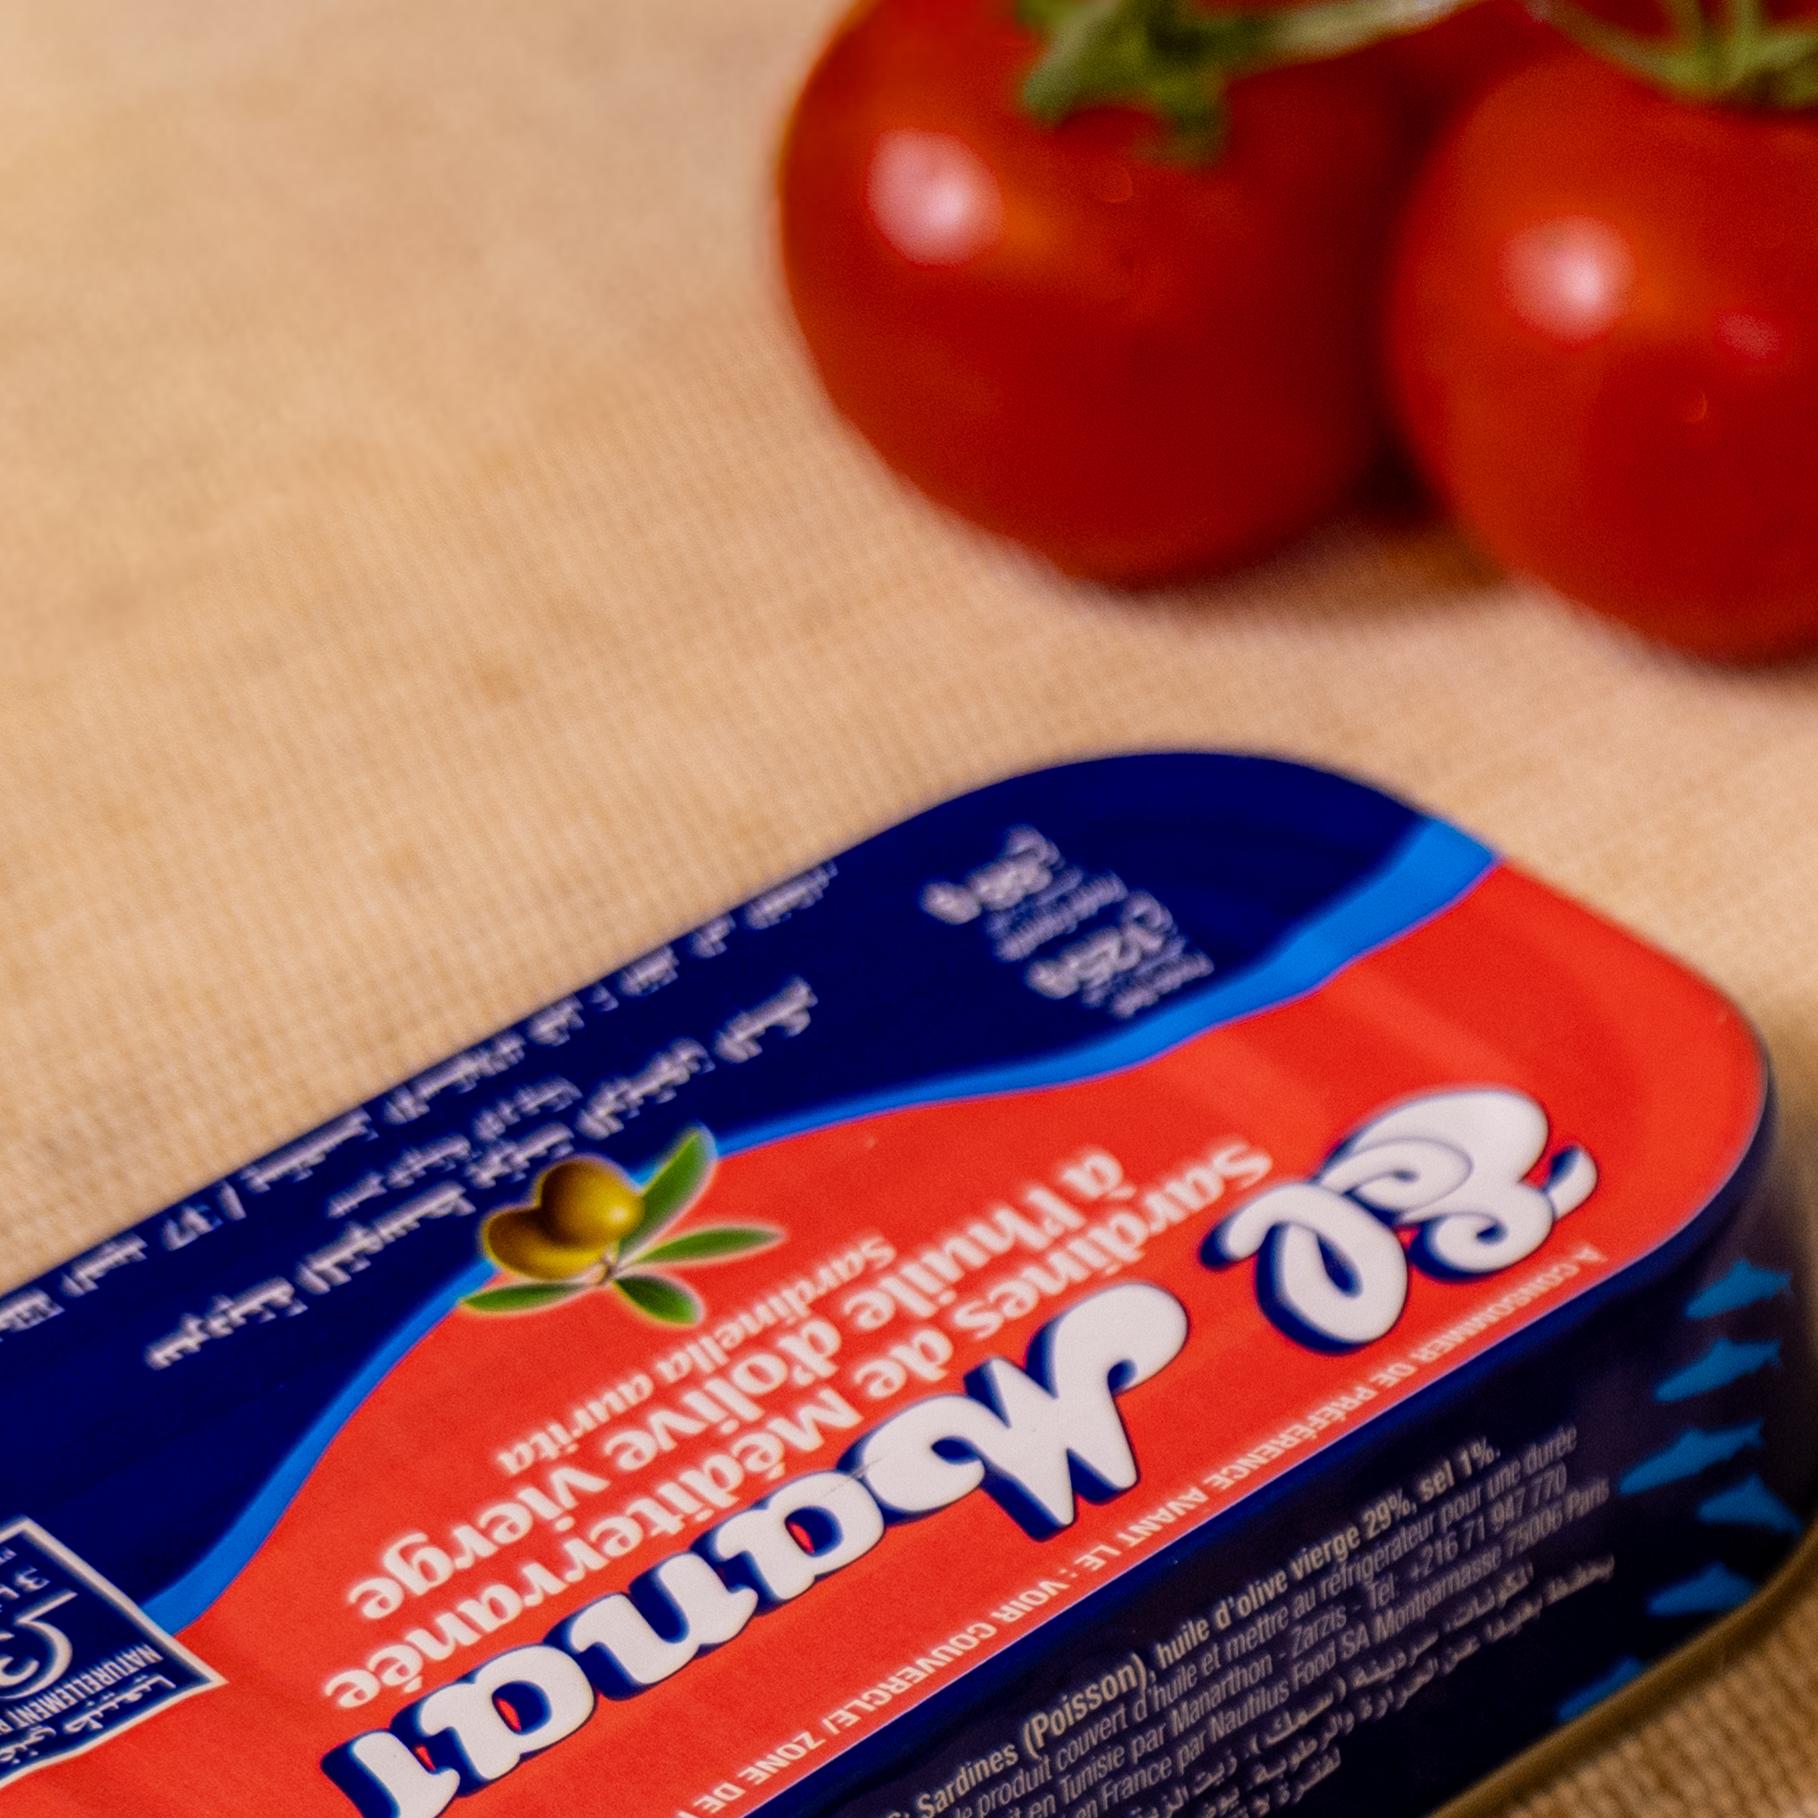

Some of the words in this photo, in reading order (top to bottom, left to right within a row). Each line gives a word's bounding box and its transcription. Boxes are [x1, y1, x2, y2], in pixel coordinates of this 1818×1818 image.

[1059, 1151, 1135, 1198] à
[1199, 1084, 1598, 1355] El
[841, 1186, 1085, 1329] l'huile
[951, 1143, 1271, 1338] Sardines
[653, 1236, 895, 1382] Sardinella
[1408, 1254, 1580, 1362] CONSOMMER
[602, 1318, 840, 1470] d'olive
[853, 1328, 951, 1398] de
[1369, 1362, 1410, 1387] DE
[496, 1373, 653, 1474] aurita
[1202, 1384, 1376, 1489] PRÉFÉRENCE
[323, 1388, 861, 1707] Méditerranée
[346, 1442, 609, 1619] vierge
[1078, 1544, 1120, 1570] LE
[1116, 1487, 1207, 1546] AVANT
[990, 1580, 1068, 1622] VOIR
[1022, 1653, 1155, 1759] (Poisson),
[1157, 1619, 1208, 1668] huile
[1213, 1570, 1286, 1629] d'olive
[1292, 1526, 1359, 1579] vierge
[1419, 1460, 1453, 1500] sel
[1057, 1703, 1126, 1771] couvert
[1132, 1664, 1196, 1721] d'huile
[1203, 1644, 1218, 1675] et
[1226, 1606, 1287, 1660] mettre
[1296, 1587, 1314, 1618] au
[1320, 1513, 1433, 1608] réfrigérateur
[1439, 1485, 1480, 1532] pour
[1487, 1460, 1520, 1498] une
[1523, 1427, 1576, 1474] durée
[3, 1643, 164, 1729] NATURELLEMENT
[64, 1674, 176, 1734] طبيعيا
[1060, 1746, 1124, 1803] Tunisie
[1131, 1723, 1165, 1763] par
[1171, 1654, 1271, 1735] Manarthon
[1292, 1606, 1346, 1658] Zarzis
[1410, 1531, 1457, 1580] +216
[1464, 1514, 1484, 1549] 71
[1102, 1756, 1171, 1810] France
[1178, 1732, 1205, 1774] par
[1208, 1679, 1288, 1741] Nautilus
[1292, 1640, 1335, 1690] Food
[1340, 1623, 1369, 1658] SA
[1372, 1545, 1500, 1642] Montparnasse
[693, 1782, 742, 1812] DE
[739, 1731, 820, 1784] ZONE
